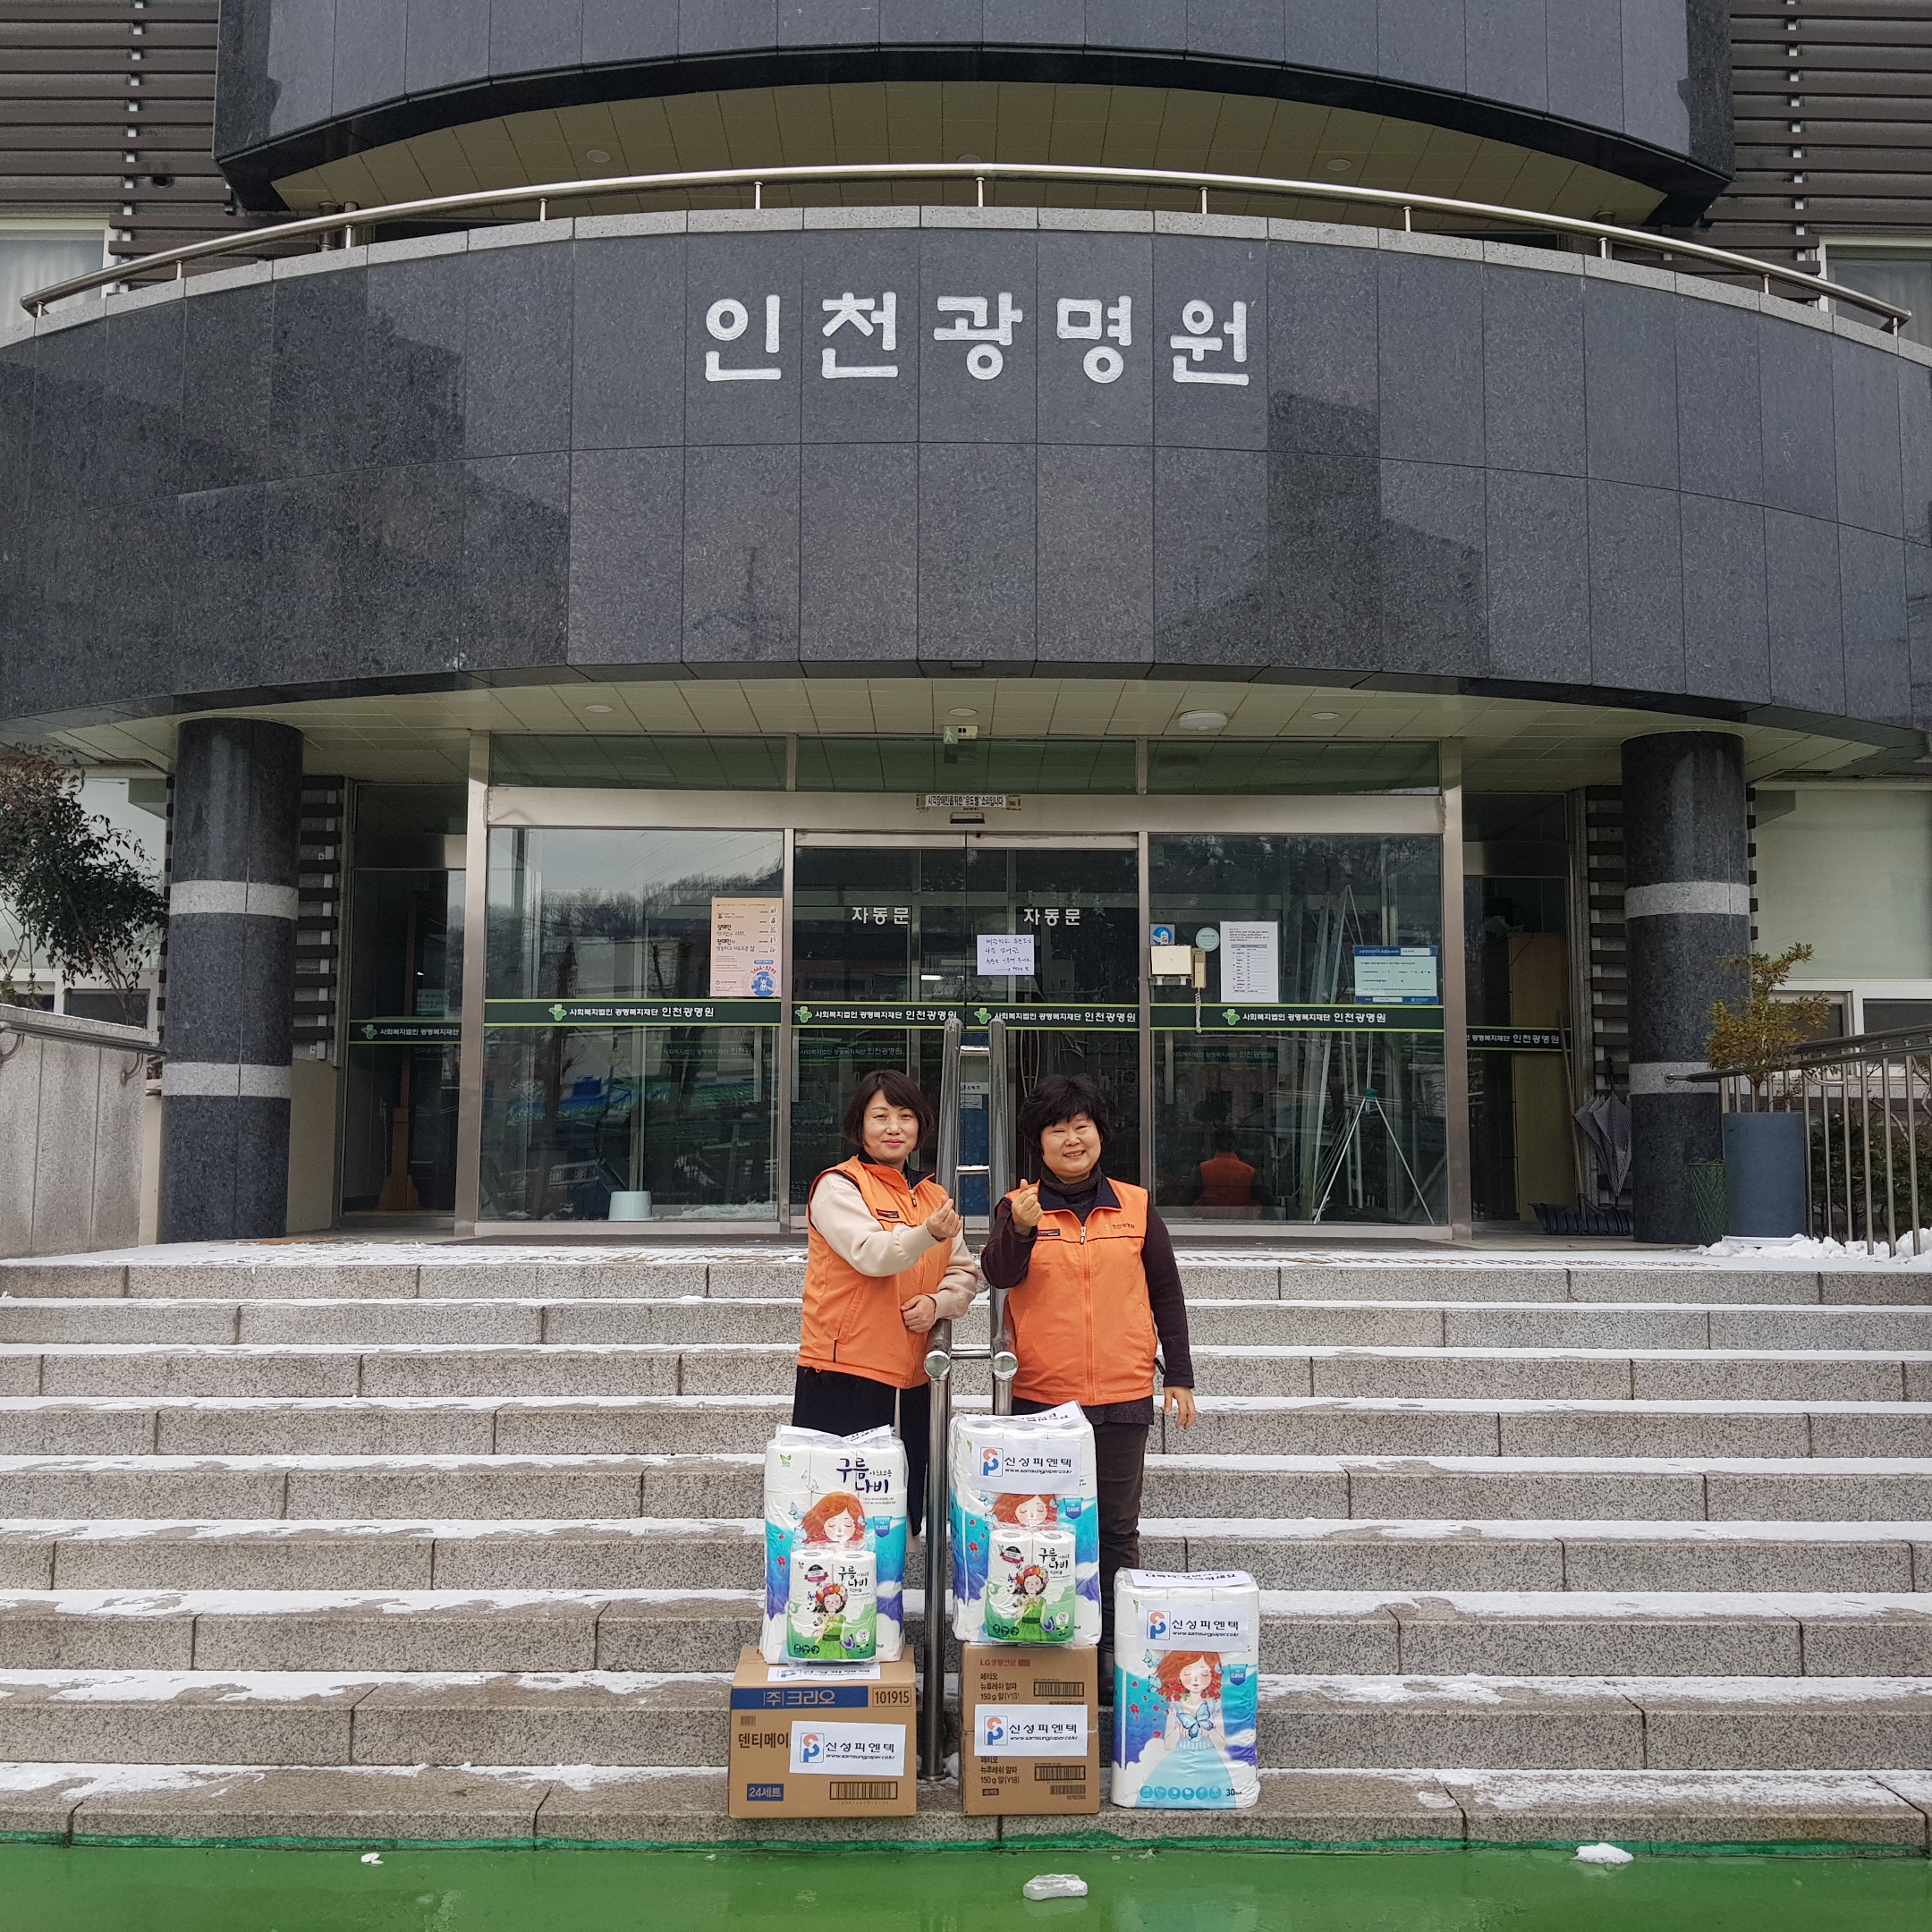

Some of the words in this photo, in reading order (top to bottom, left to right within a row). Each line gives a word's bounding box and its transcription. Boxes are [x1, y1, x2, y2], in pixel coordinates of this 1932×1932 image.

[705, 292, 1250, 385] 인천광명원
[852, 907, 910, 926] 자동문
[1023, 908, 1080, 927] 자동문
[569, 1007, 613, 1017] 사회복지법인
[614, 1008, 658, 1017] 광명복지재단
[661, 1007, 714, 1018] 인천광명원
[815, 1011, 858, 1019] 사회복지법인
[859, 1011, 902, 1020] 광명복지재단
[994, 1012, 1037, 1021] 사회복지법인
[1038, 1013, 1081, 1021] 광명복지재단
[1084, 1012, 1136, 1023] 인천광명원
[1242, 1013, 1285, 1021] 사회복지법인
[1287, 1013, 1331, 1021] 광명복지재단
[1334, 1012, 1386, 1023] 인천광명원
[380, 1028, 419, 1036] 사회복지법인
[420, 1028, 459, 1036] 광명복지재단
[1471, 1034, 1510, 1042] 광명복지재단
[1513, 1033, 1560, 1044] 인천광명원
[1004, 1457, 1072, 1468] 신성피엔텍
[835, 1457, 869, 1483] 구름
[855, 1479, 889, 1494] 나비
[1038, 1547, 1058, 1563] 구름
[1049, 1560, 1069, 1570] 나비
[837, 1565, 857, 1582] 구름
[848, 1578, 868, 1588] 나비
[1172, 1620, 1239, 1631] 신성피엔텍
[980, 1659, 1016, 1667] LG생활건강
[980, 1673, 998, 1681] 페리오
[874, 1690, 910, 1704] 101915
[1009, 1724, 1077, 1734] 신성피엔텍
[738, 1733, 791, 1749] 덴티메이
[825, 1741, 894, 1753] 신성피엔텍
[749, 1787, 782, 1798] 24세트
